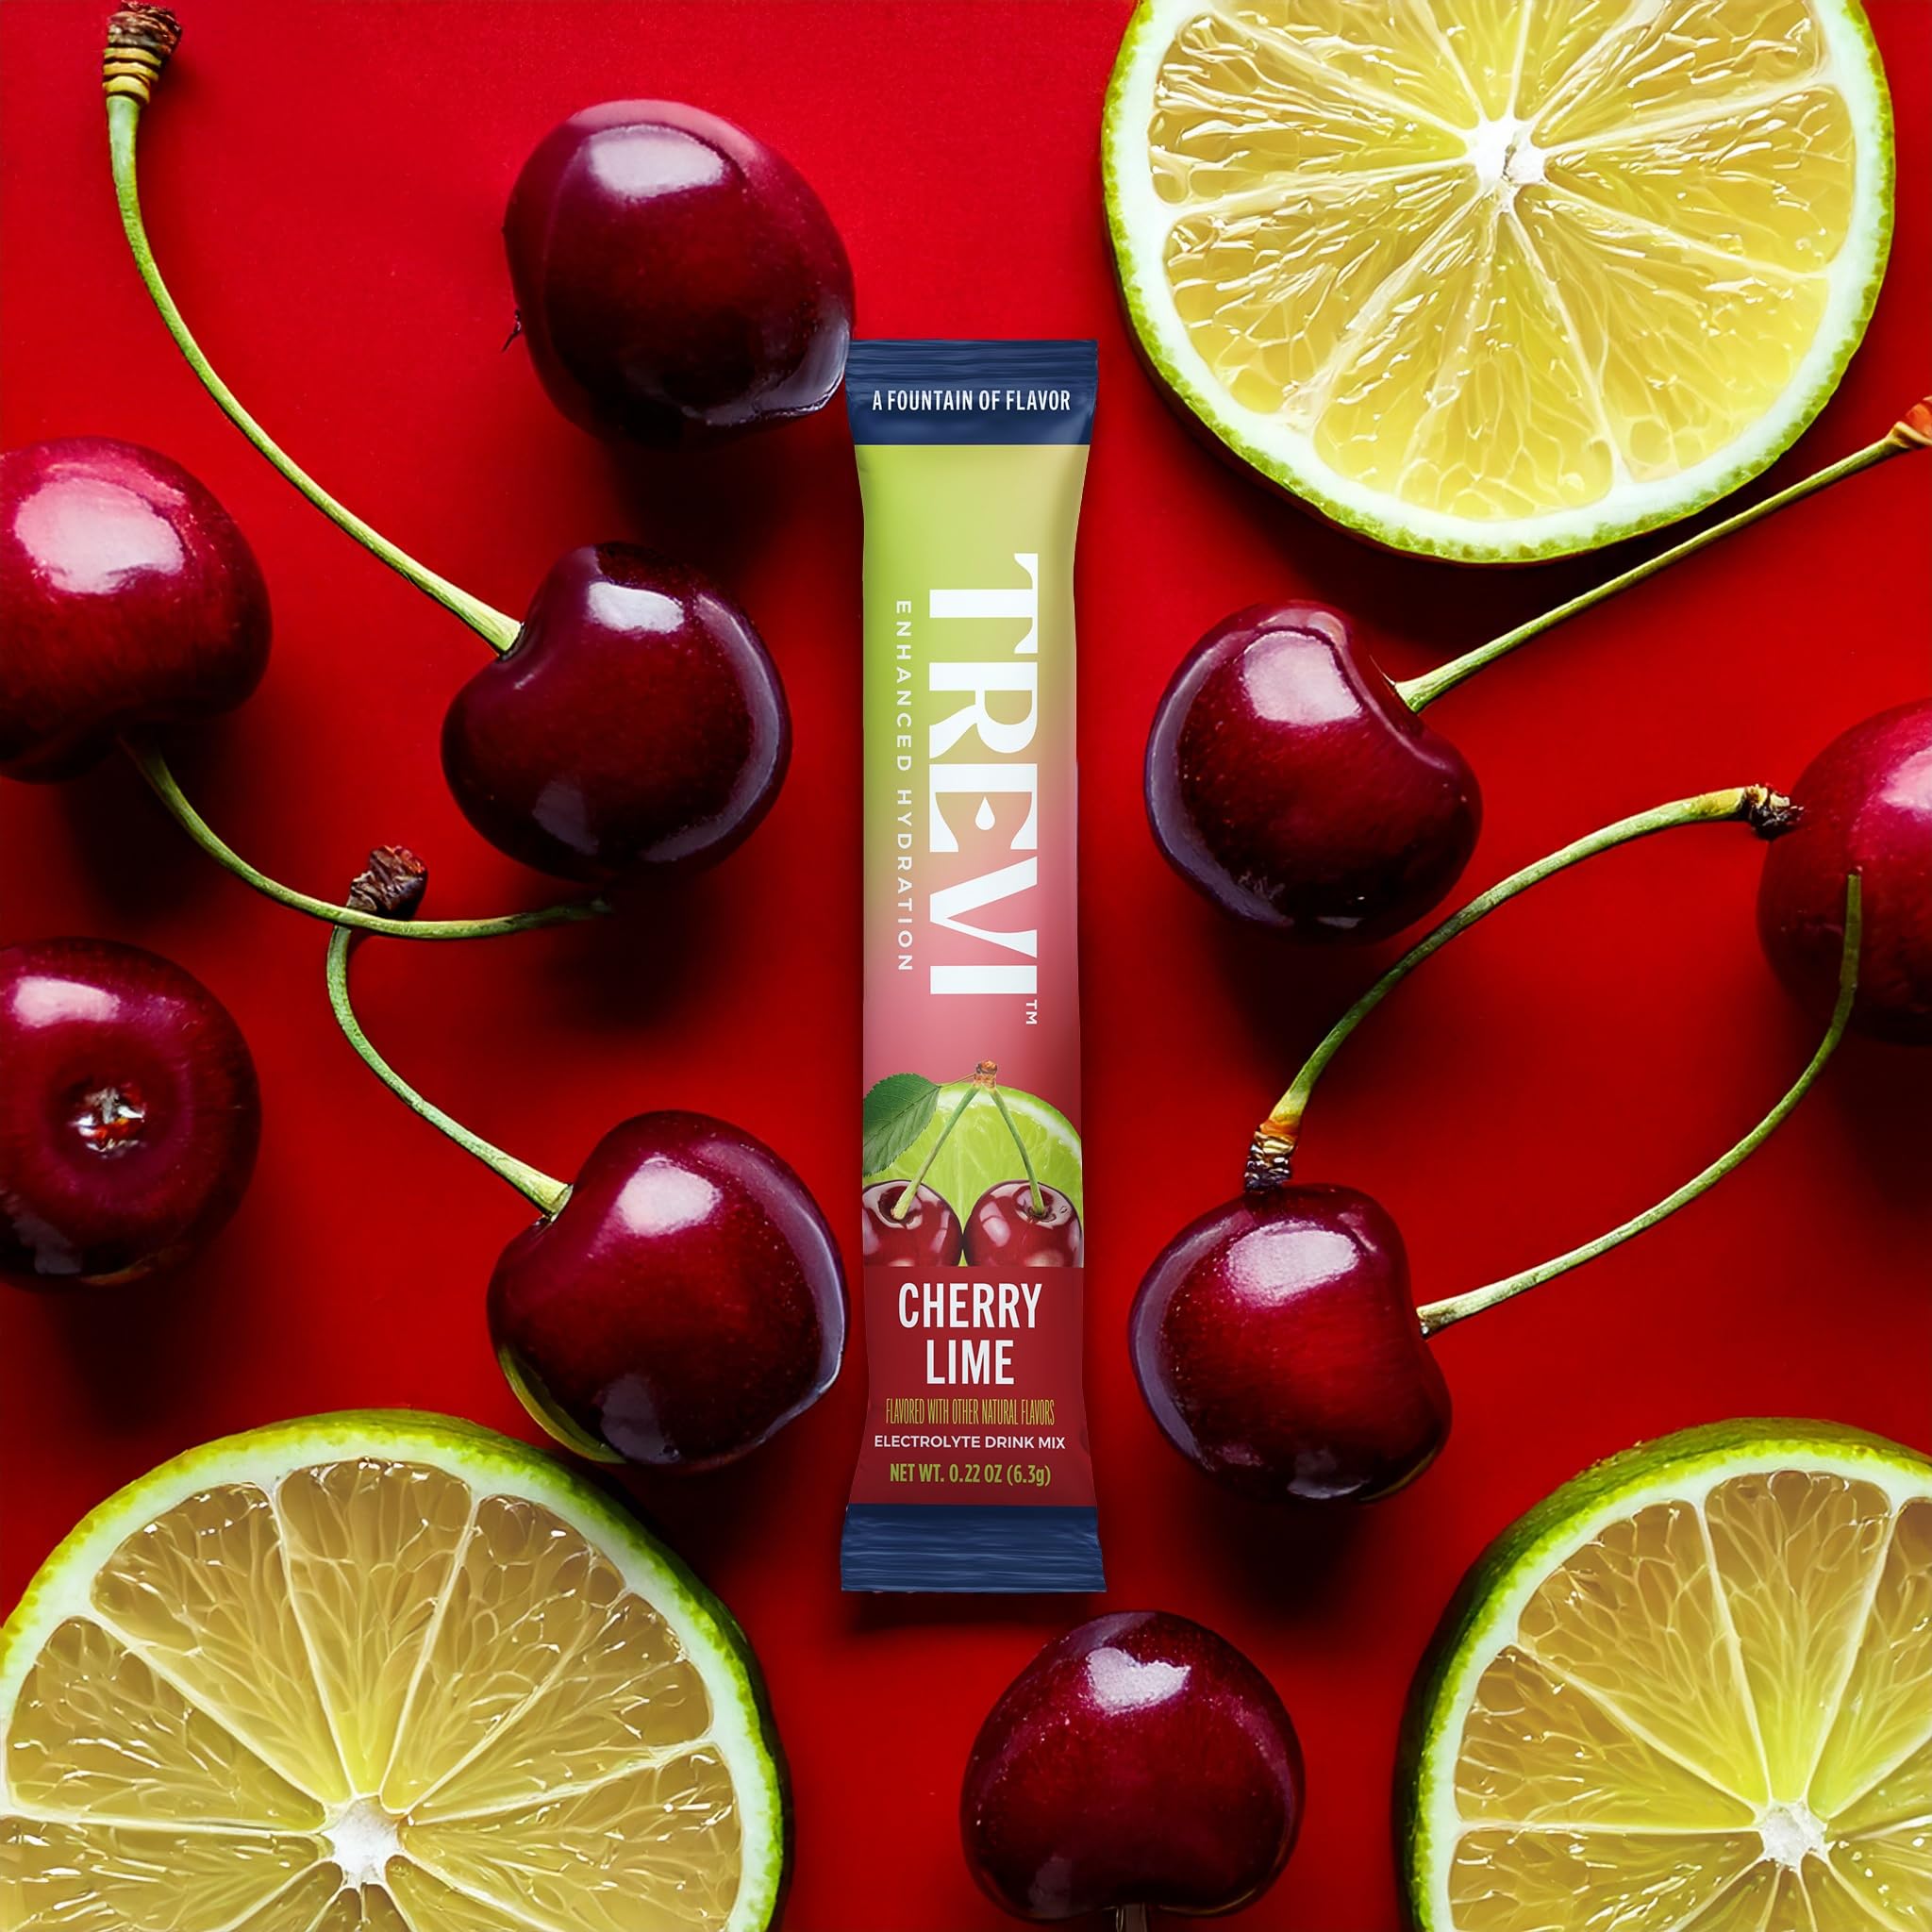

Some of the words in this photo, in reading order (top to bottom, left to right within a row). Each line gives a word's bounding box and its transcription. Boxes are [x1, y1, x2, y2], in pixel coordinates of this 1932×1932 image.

[872, 390, 883, 411] A
[888, 390, 973, 411] FOUNTAIN
[978, 390, 1001, 411] OF
[1006, 390, 1071, 411] FLAVOR
[896, 600, 912, 772] ENHANCED
[929, 553, 1039, 994] TREVI
[897, 790, 913, 971] HYDRATION
[898, 1282, 1042, 1328] CHERRY
[926, 1340, 1015, 1385] LIME
[886, 1398, 924, 1424] FLAVORED
[927, 1399, 949, 1424] WITH
[952, 1399, 979, 1425] OTHER
[981, 1399, 1019, 1425] NATURAL
[1021, 1400, 1055, 1426] FLAVORS
[874, 1435, 981, 1449] ELECTROLYTE
[984, 1436, 1035, 1449] DRINK
[1038, 1437, 1066, 1450] MIX
[890, 1463, 916, 1482] NET
[918, 1464, 944, 1483] WT.
[949, 1464, 981, 1483] 0.22
[984, 1464, 1003, 1484] OZ
[1007, 1465, 1051, 1487] (6.3g)
